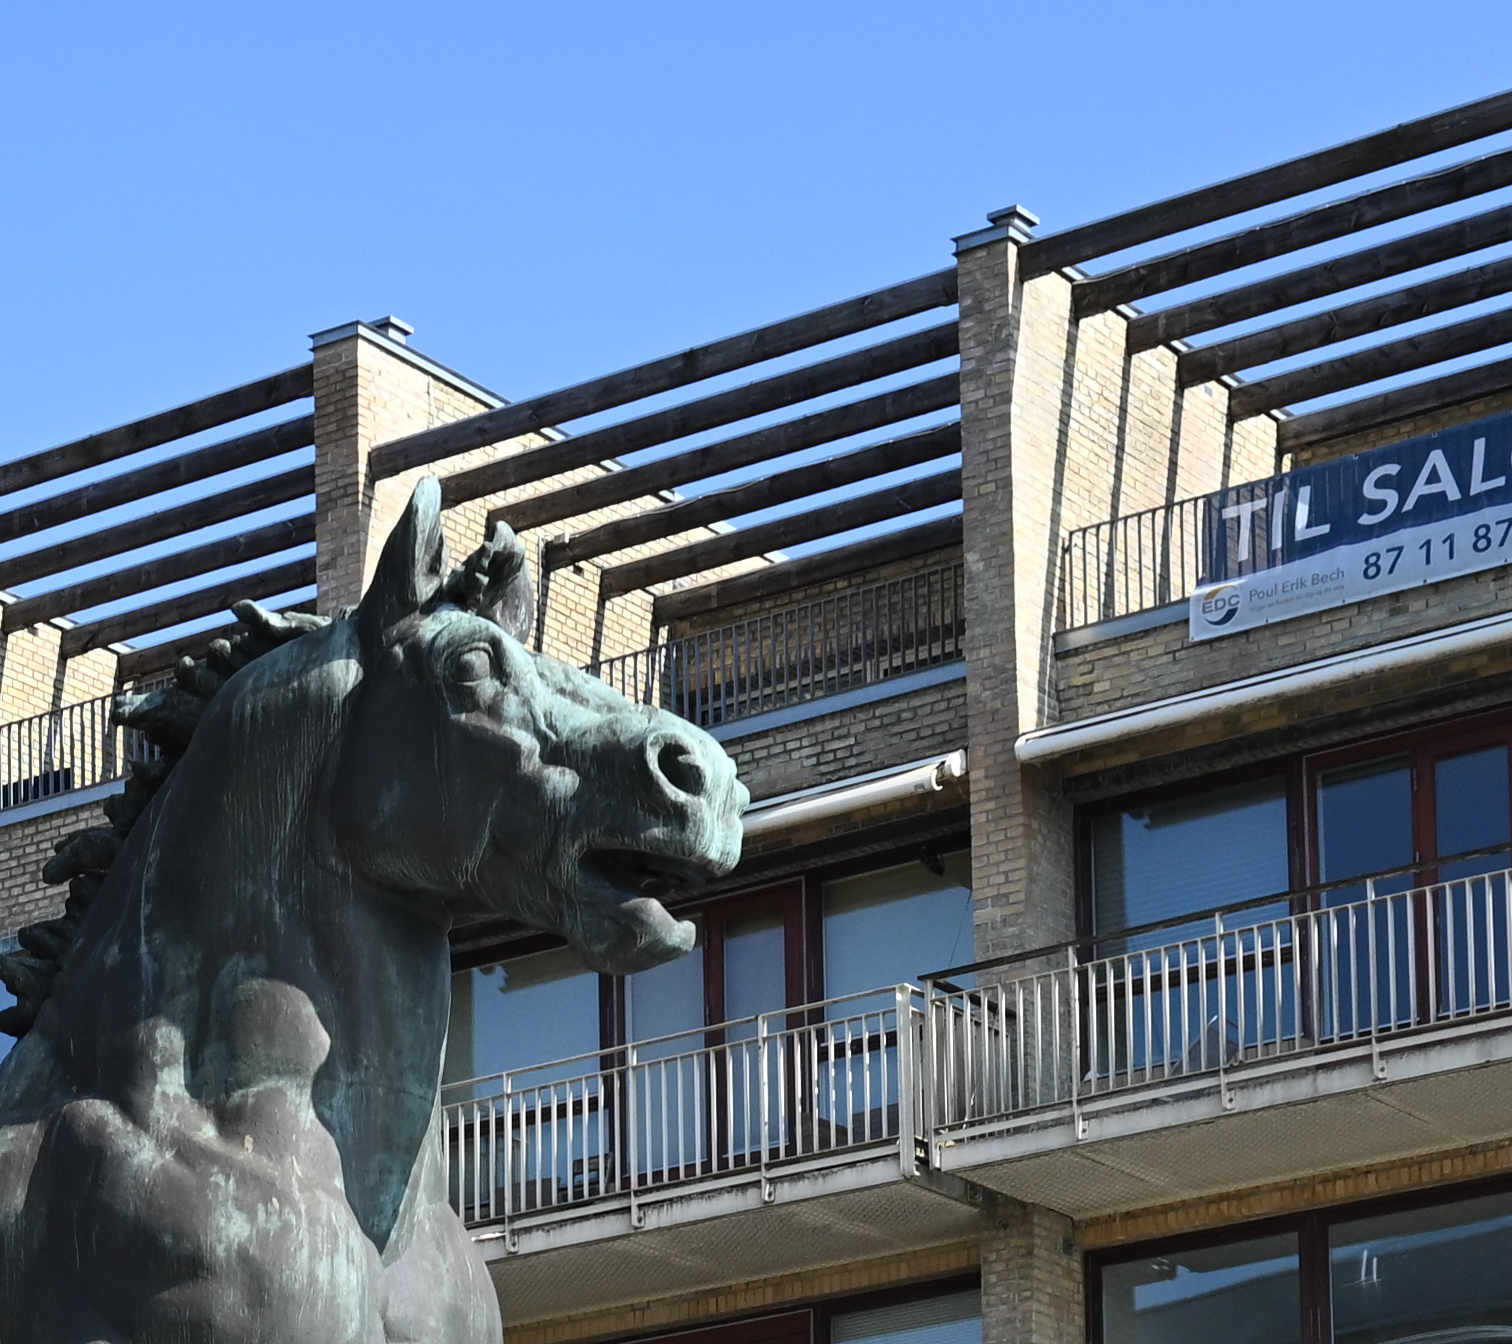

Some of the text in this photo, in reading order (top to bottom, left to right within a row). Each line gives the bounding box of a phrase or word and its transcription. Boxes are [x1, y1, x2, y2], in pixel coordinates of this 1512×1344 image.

[1222, 484, 1330, 562] TIL
[1362, 545, 1404, 581] 87
[1418, 534, 1456, 566] 11
[1202, 594, 1241, 615] EDC
[1249, 584, 1278, 602] Poul
[1282, 576, 1307, 594] Erik
[1311, 567, 1345, 586] Bech
